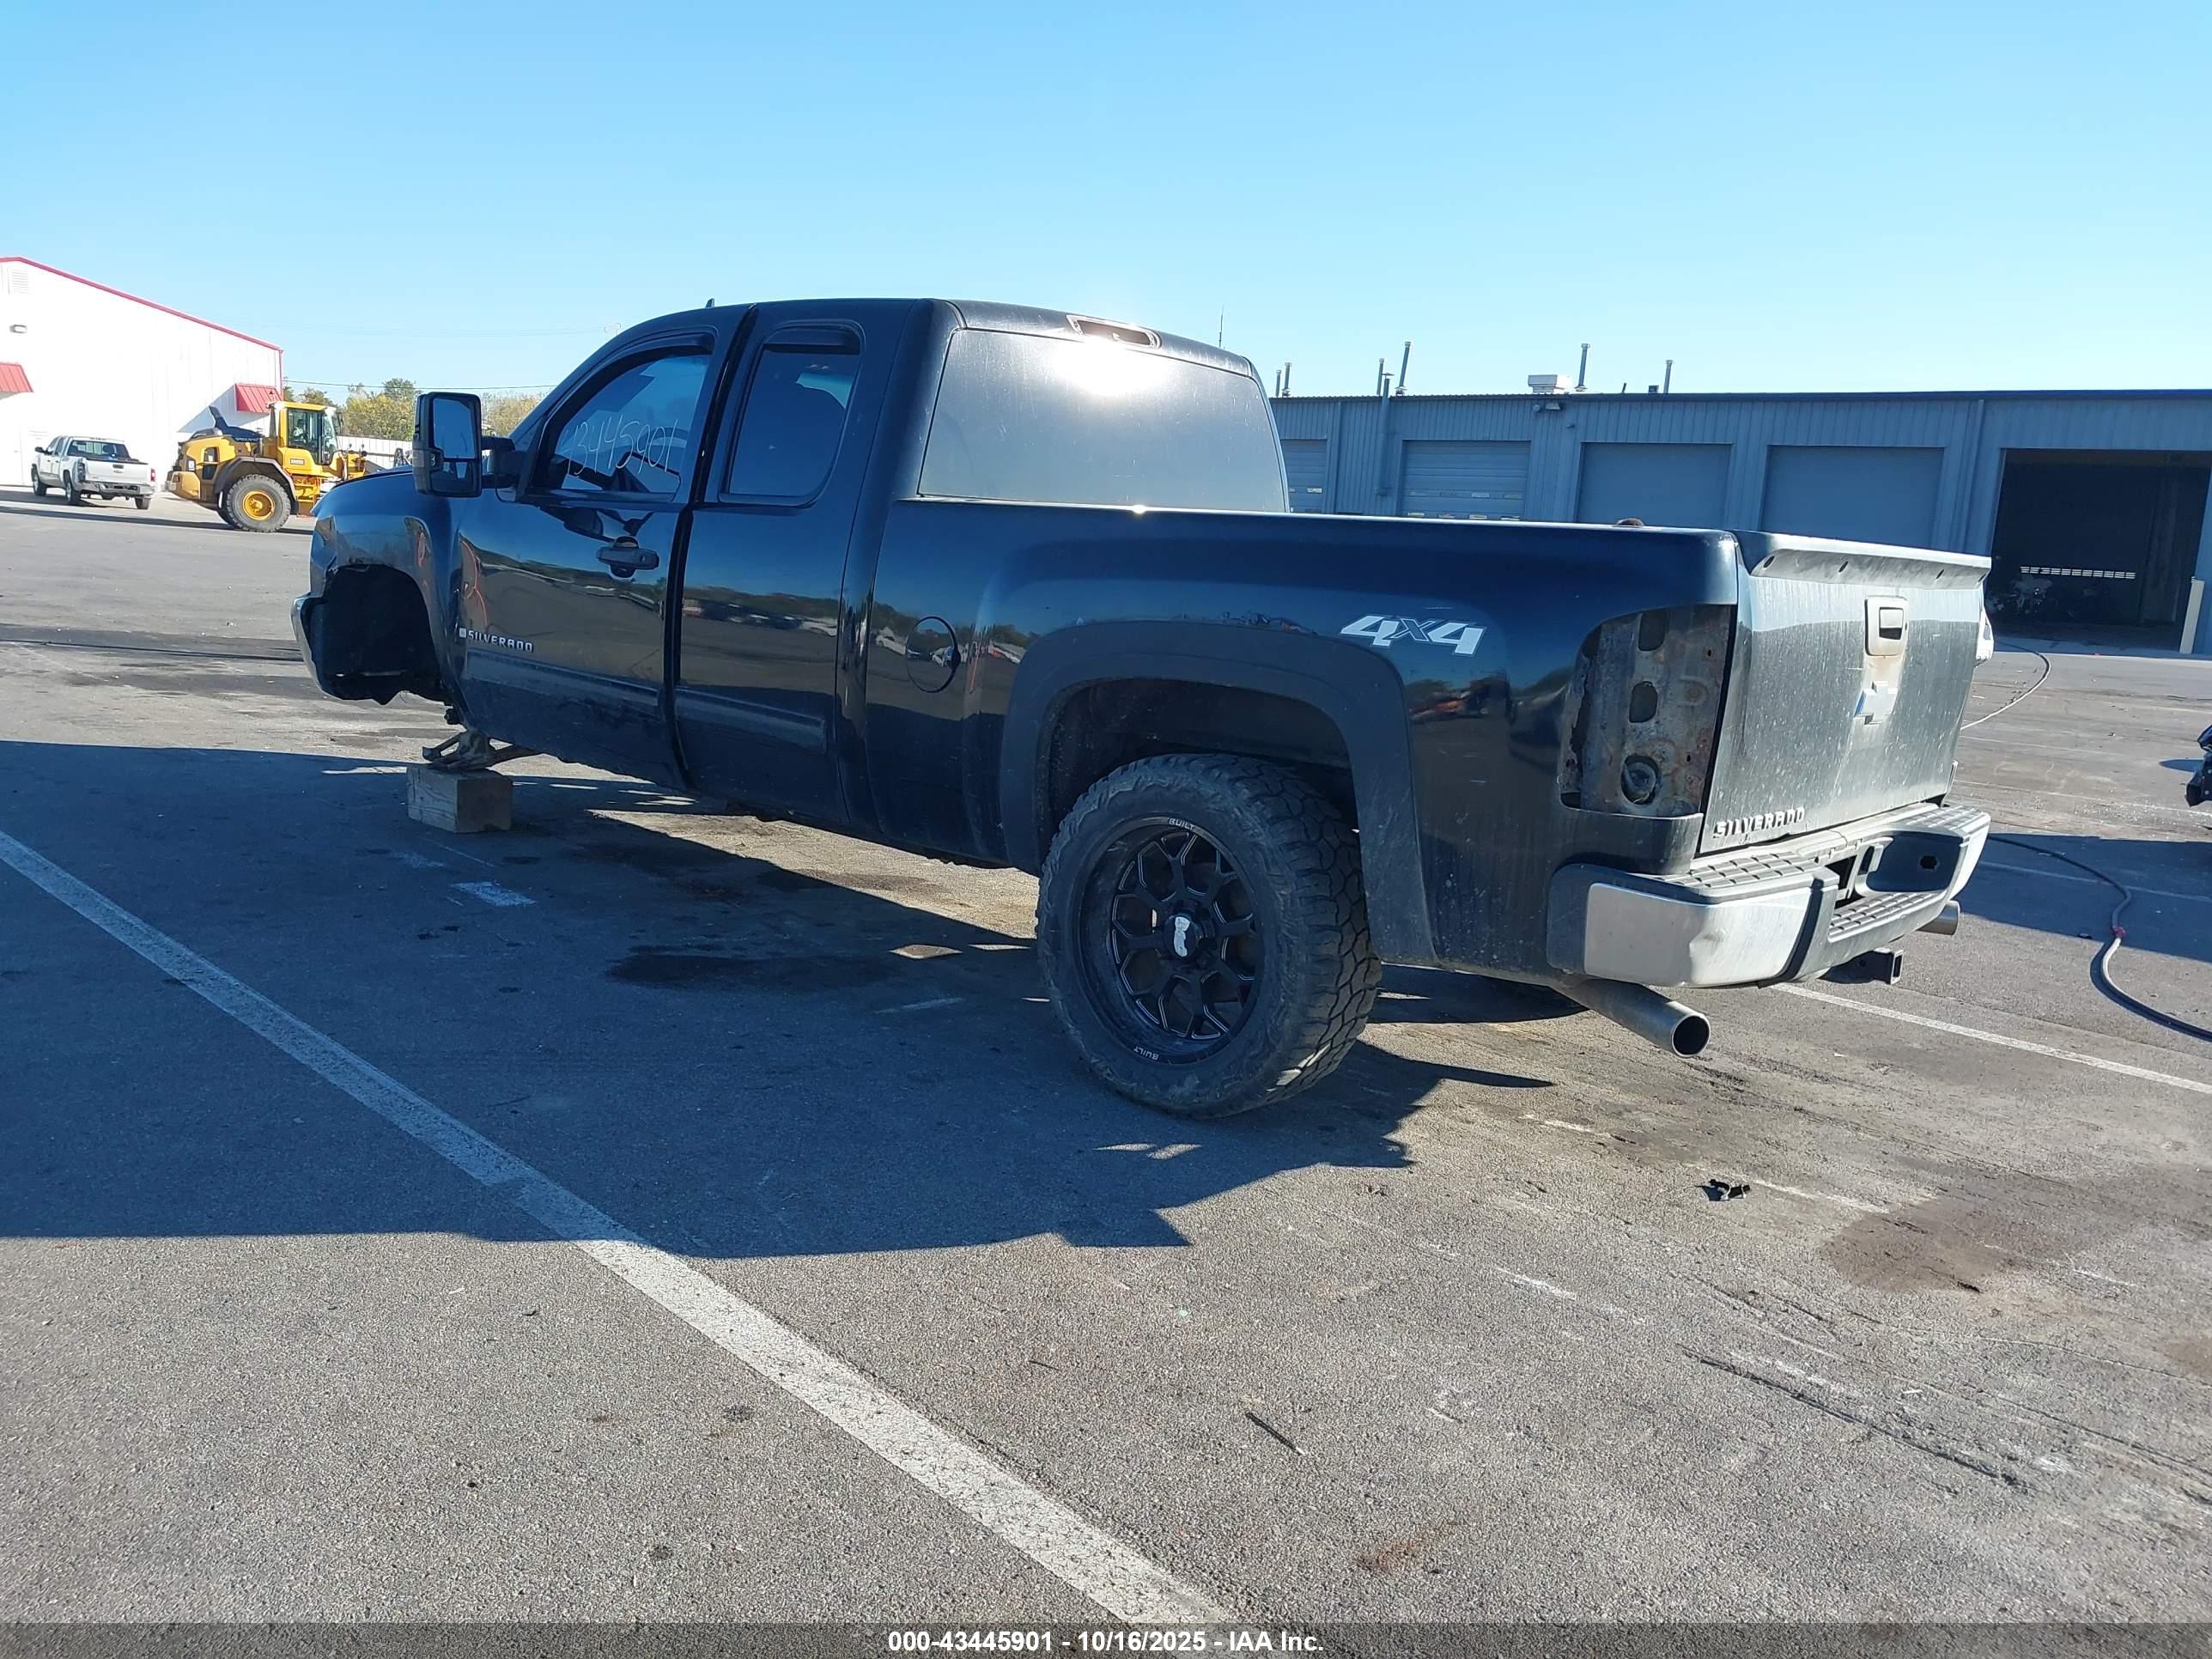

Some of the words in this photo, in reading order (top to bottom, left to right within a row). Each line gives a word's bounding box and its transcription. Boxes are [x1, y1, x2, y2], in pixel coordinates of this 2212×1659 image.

[468, 629, 533, 653] SILVERADO
[1168, 817, 1196, 831] BUILT
[1714, 806, 1806, 838] SILVERADO
[1133, 1044, 1160, 1061] BUILT
